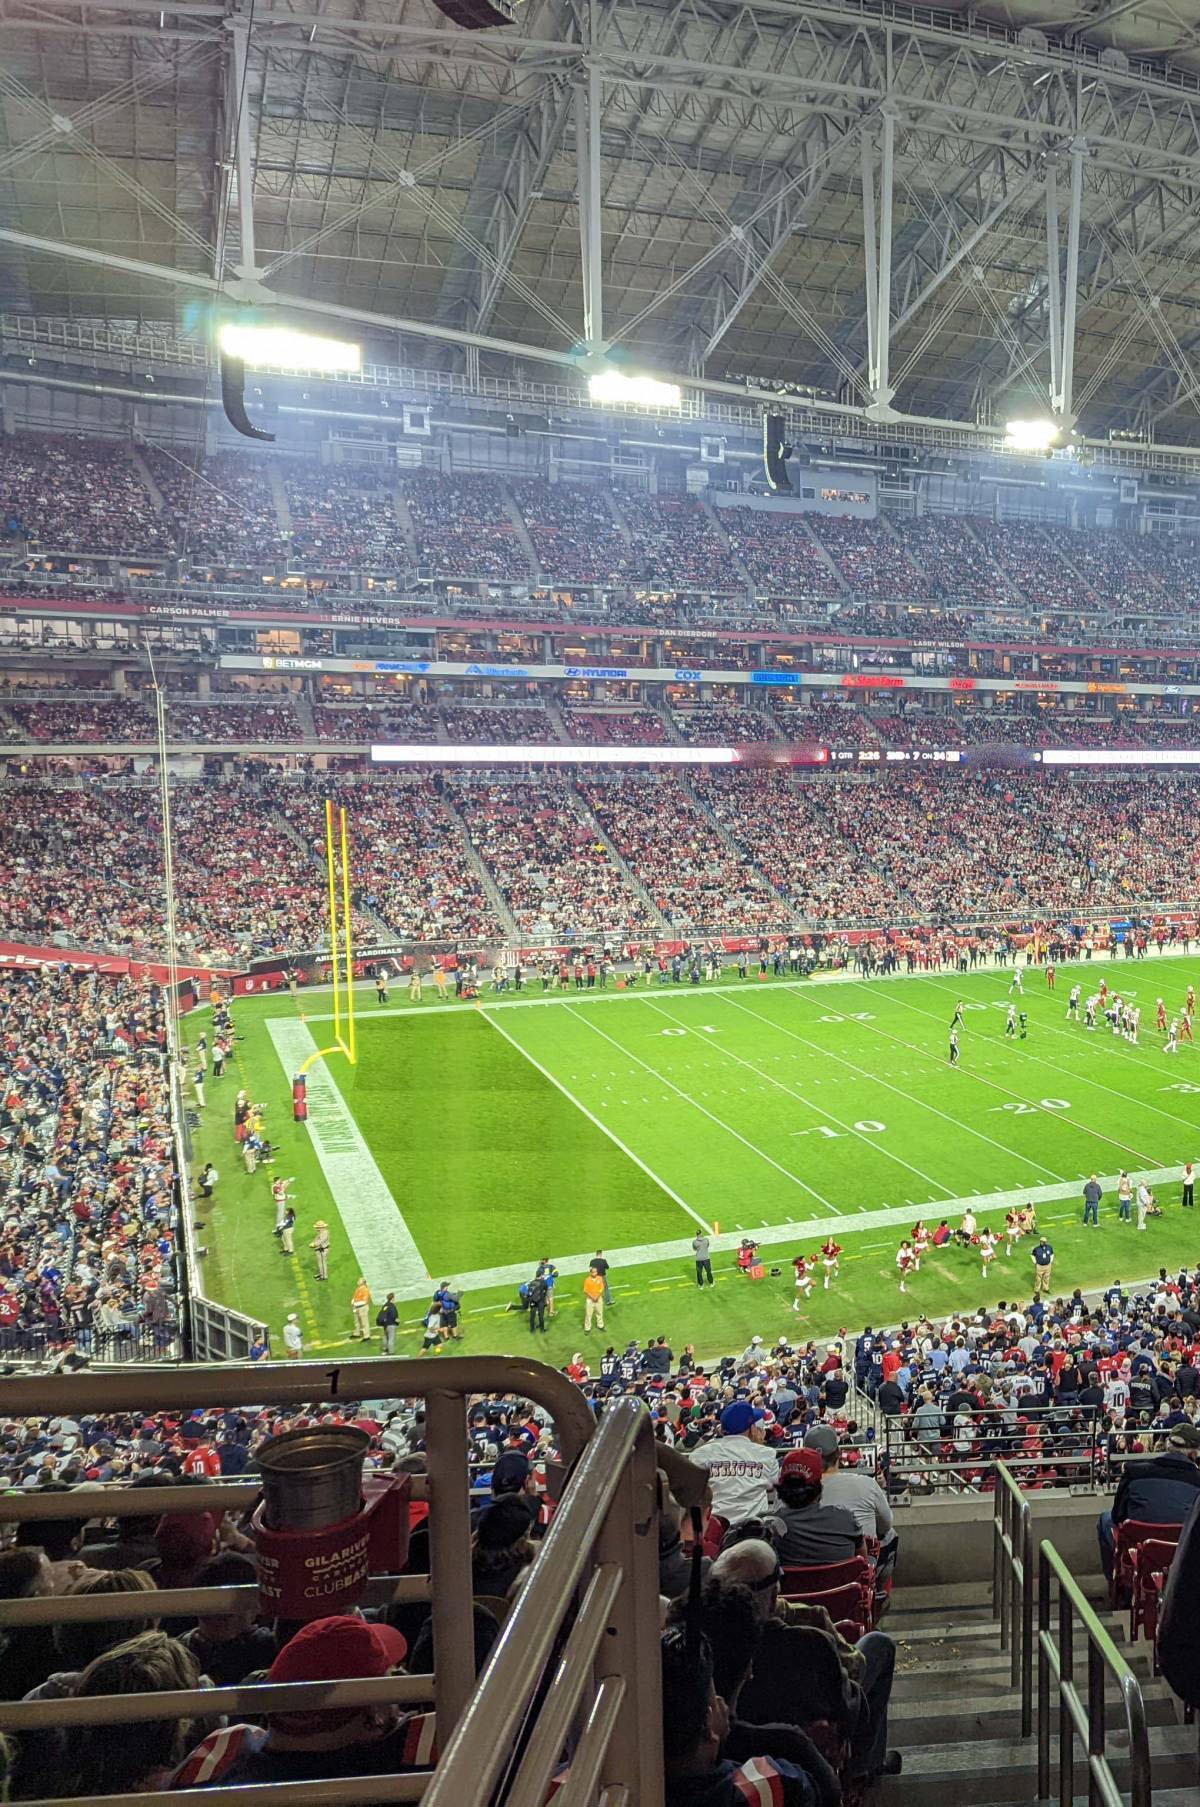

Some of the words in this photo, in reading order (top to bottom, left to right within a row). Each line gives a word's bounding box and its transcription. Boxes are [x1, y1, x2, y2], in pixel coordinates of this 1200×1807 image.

[149, 606, 189, 615] CARSON
[191, 608, 230, 617] PALMER
[331, 615, 360, 623] ERNIE
[362, 617, 400, 625] NEVERS
[582, 669, 627, 677] HYUNDAI
[675, 671, 701, 680] COX
[356, 948, 402, 957] CARDINALS
[820, 1012, 877, 1023] 20
[661, 1025, 724, 1036] 10
[1003, 1098, 1071, 1115] 20
[807, 1120, 886, 1138] 10
[872, 1353, 882, 1365] 10
[601, 1363, 614, 1375] 87
[621, 1368, 633, 1380] 32
[327, 1370, 340, 1395] 1
[1113, 1392, 1125, 1407] 10
[193, 1461, 204, 1474] 10
